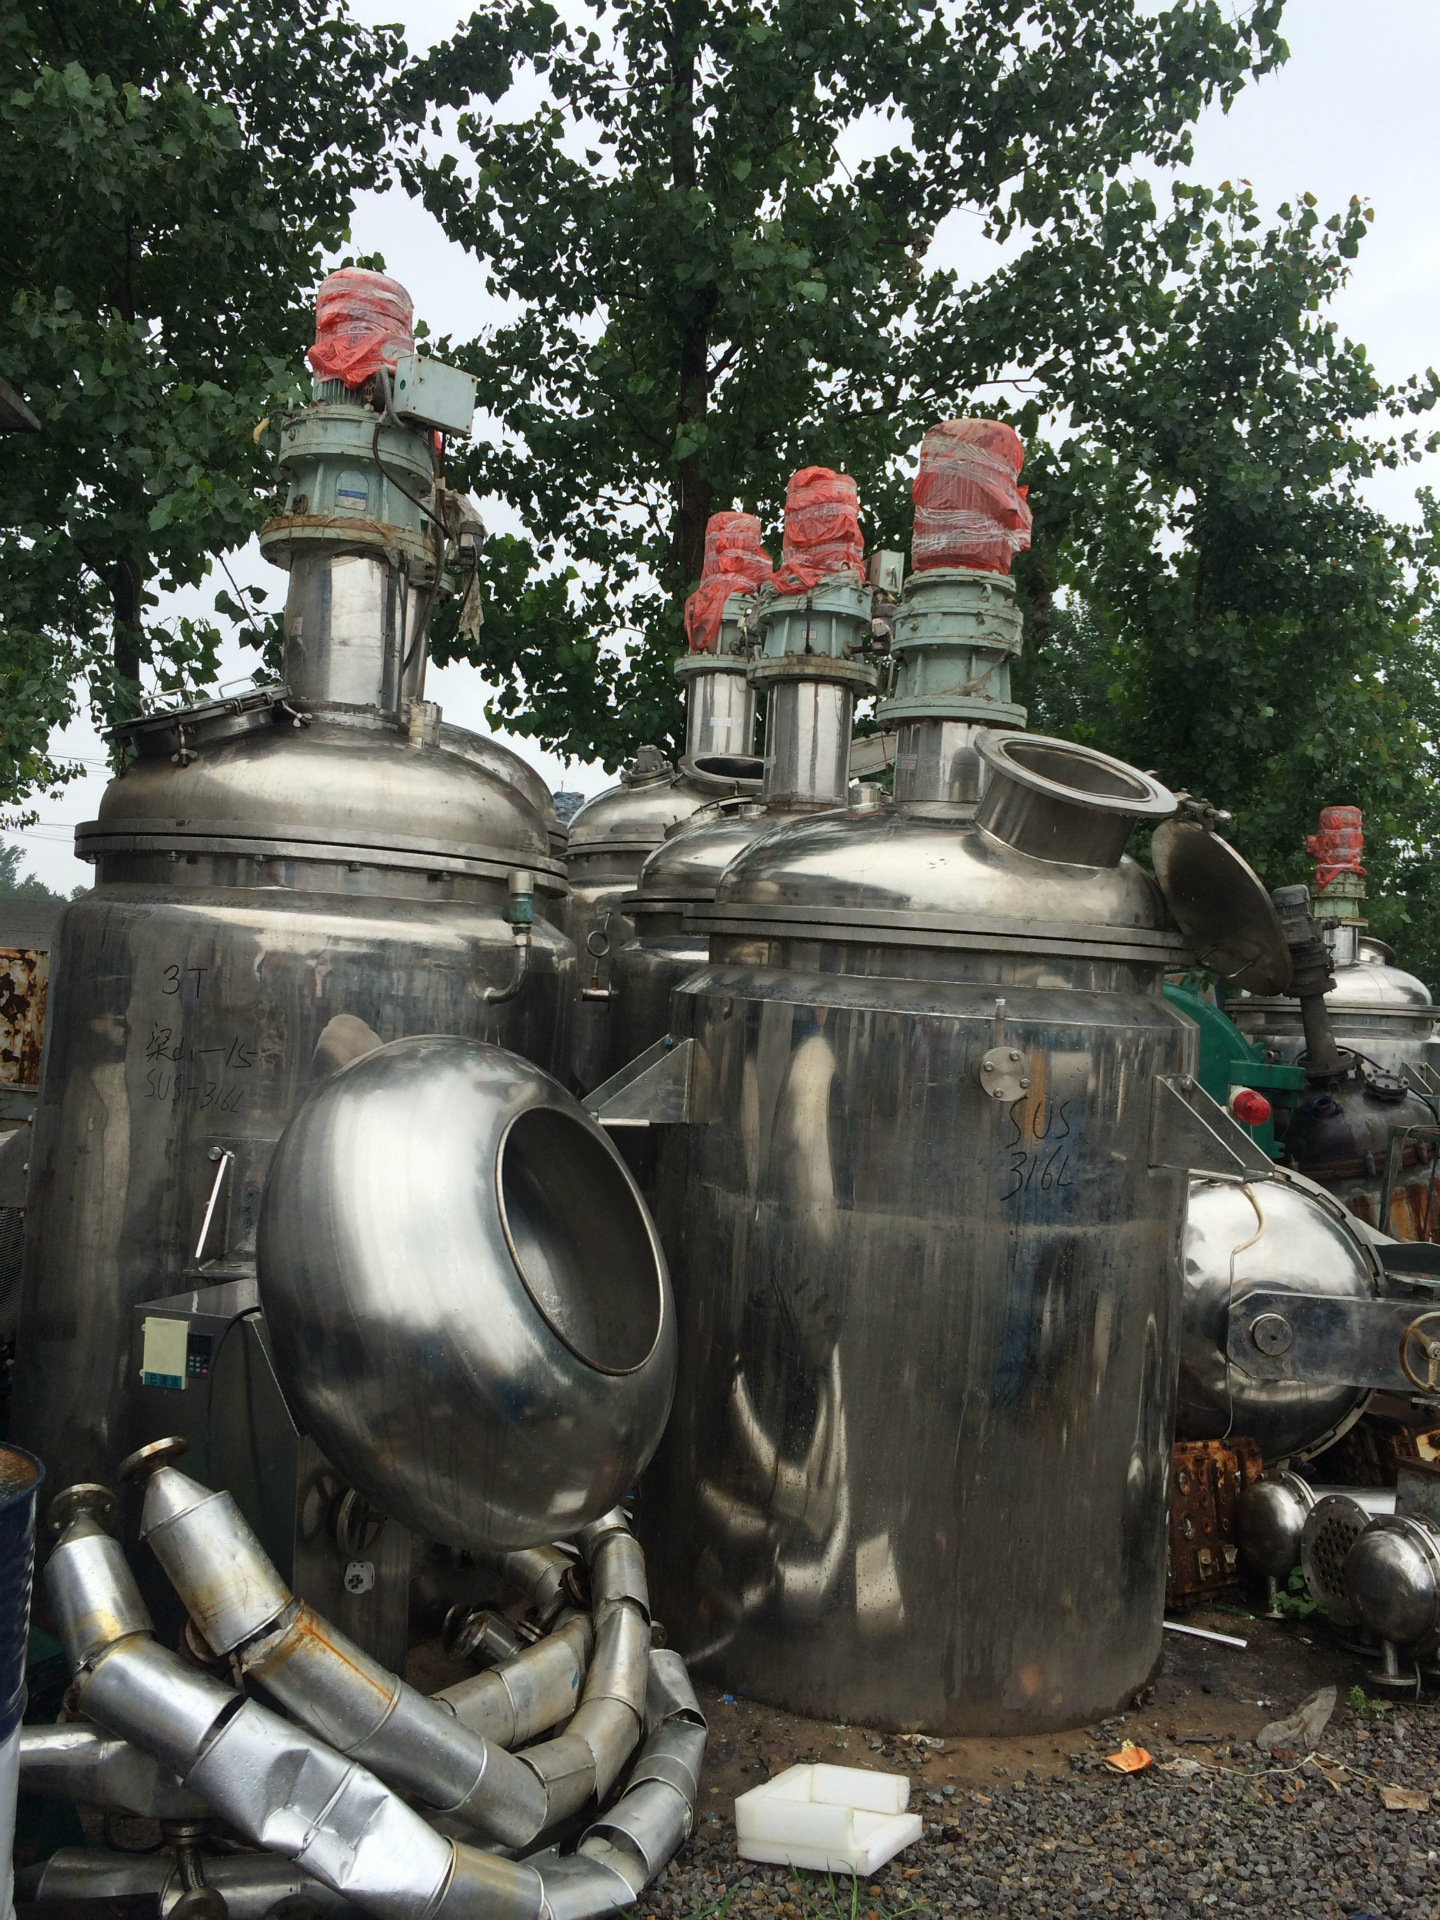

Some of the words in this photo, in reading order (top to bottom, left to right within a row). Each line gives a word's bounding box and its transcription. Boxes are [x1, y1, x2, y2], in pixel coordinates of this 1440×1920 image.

[162, 964, 208, 999] 3T
[1005, 1095, 1071, 1149] SUS
[1000, 1145, 1073, 1201] 316L
